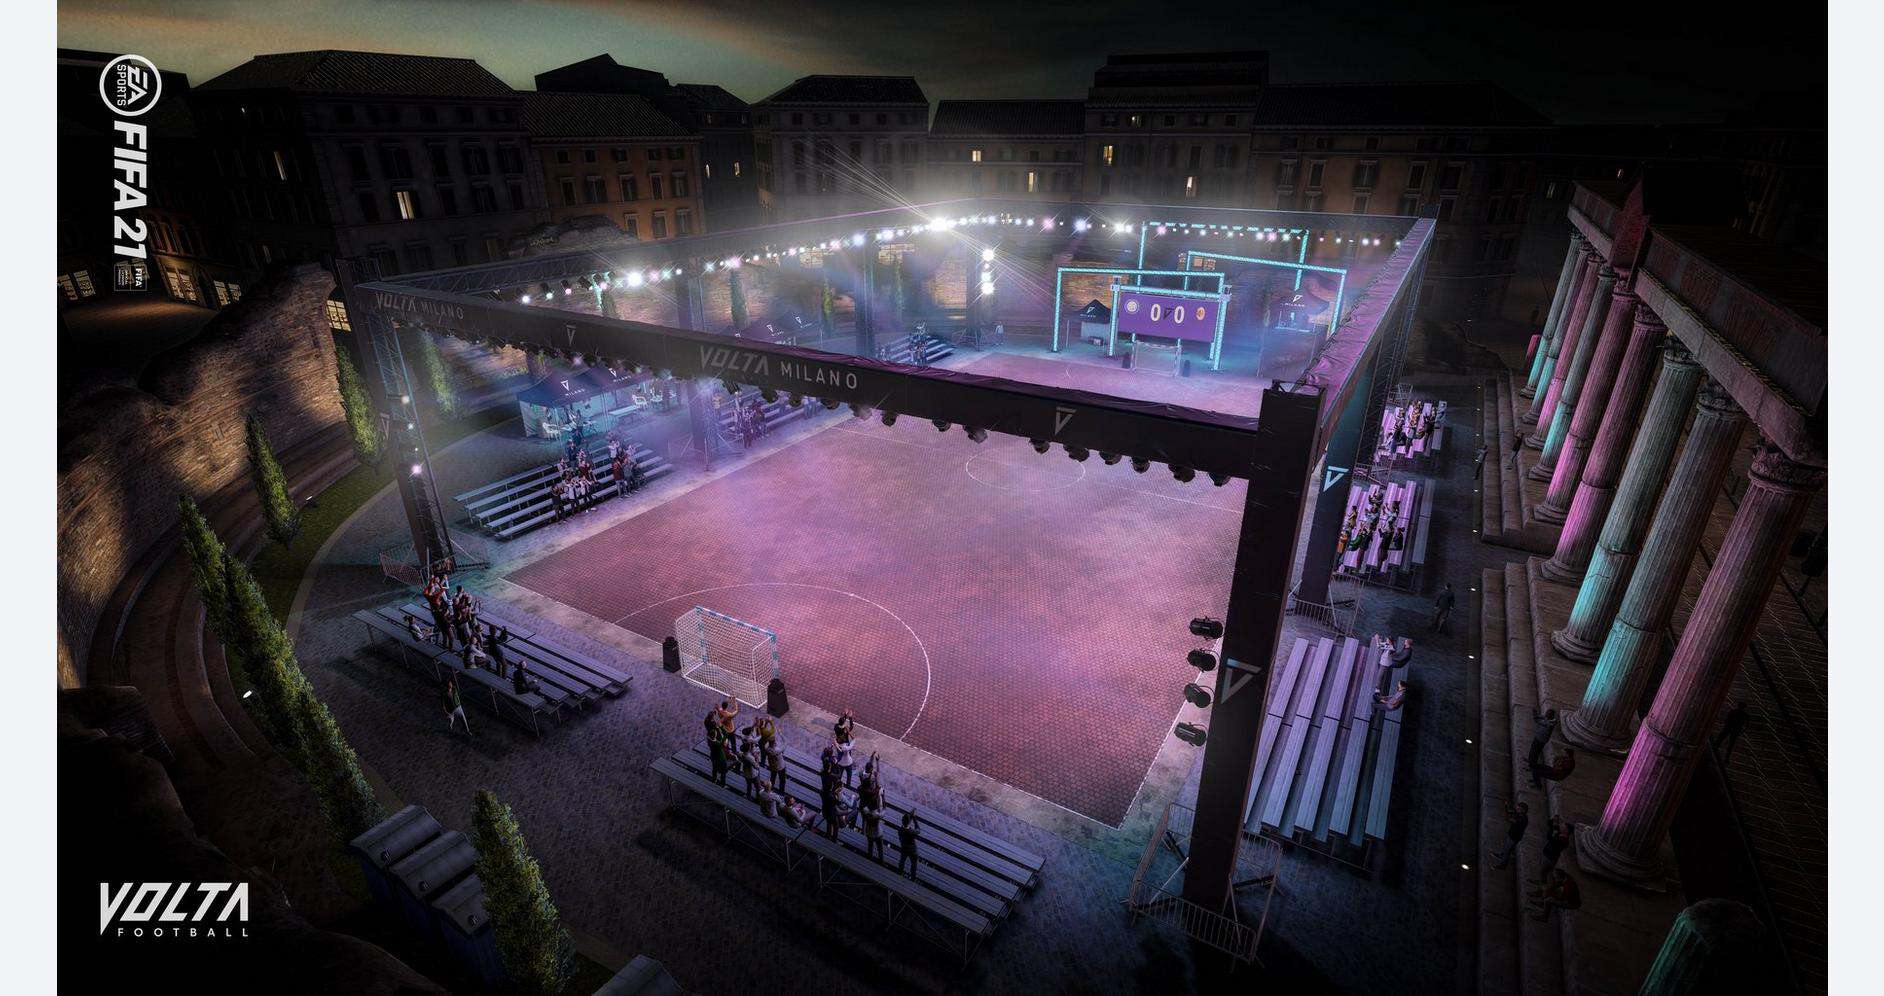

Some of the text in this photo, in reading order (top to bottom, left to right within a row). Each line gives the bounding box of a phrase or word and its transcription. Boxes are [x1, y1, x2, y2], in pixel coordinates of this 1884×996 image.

[375, 292, 464, 320] VOLTA MILANO
[700, 345, 858, 389] VOLTA MILANO
